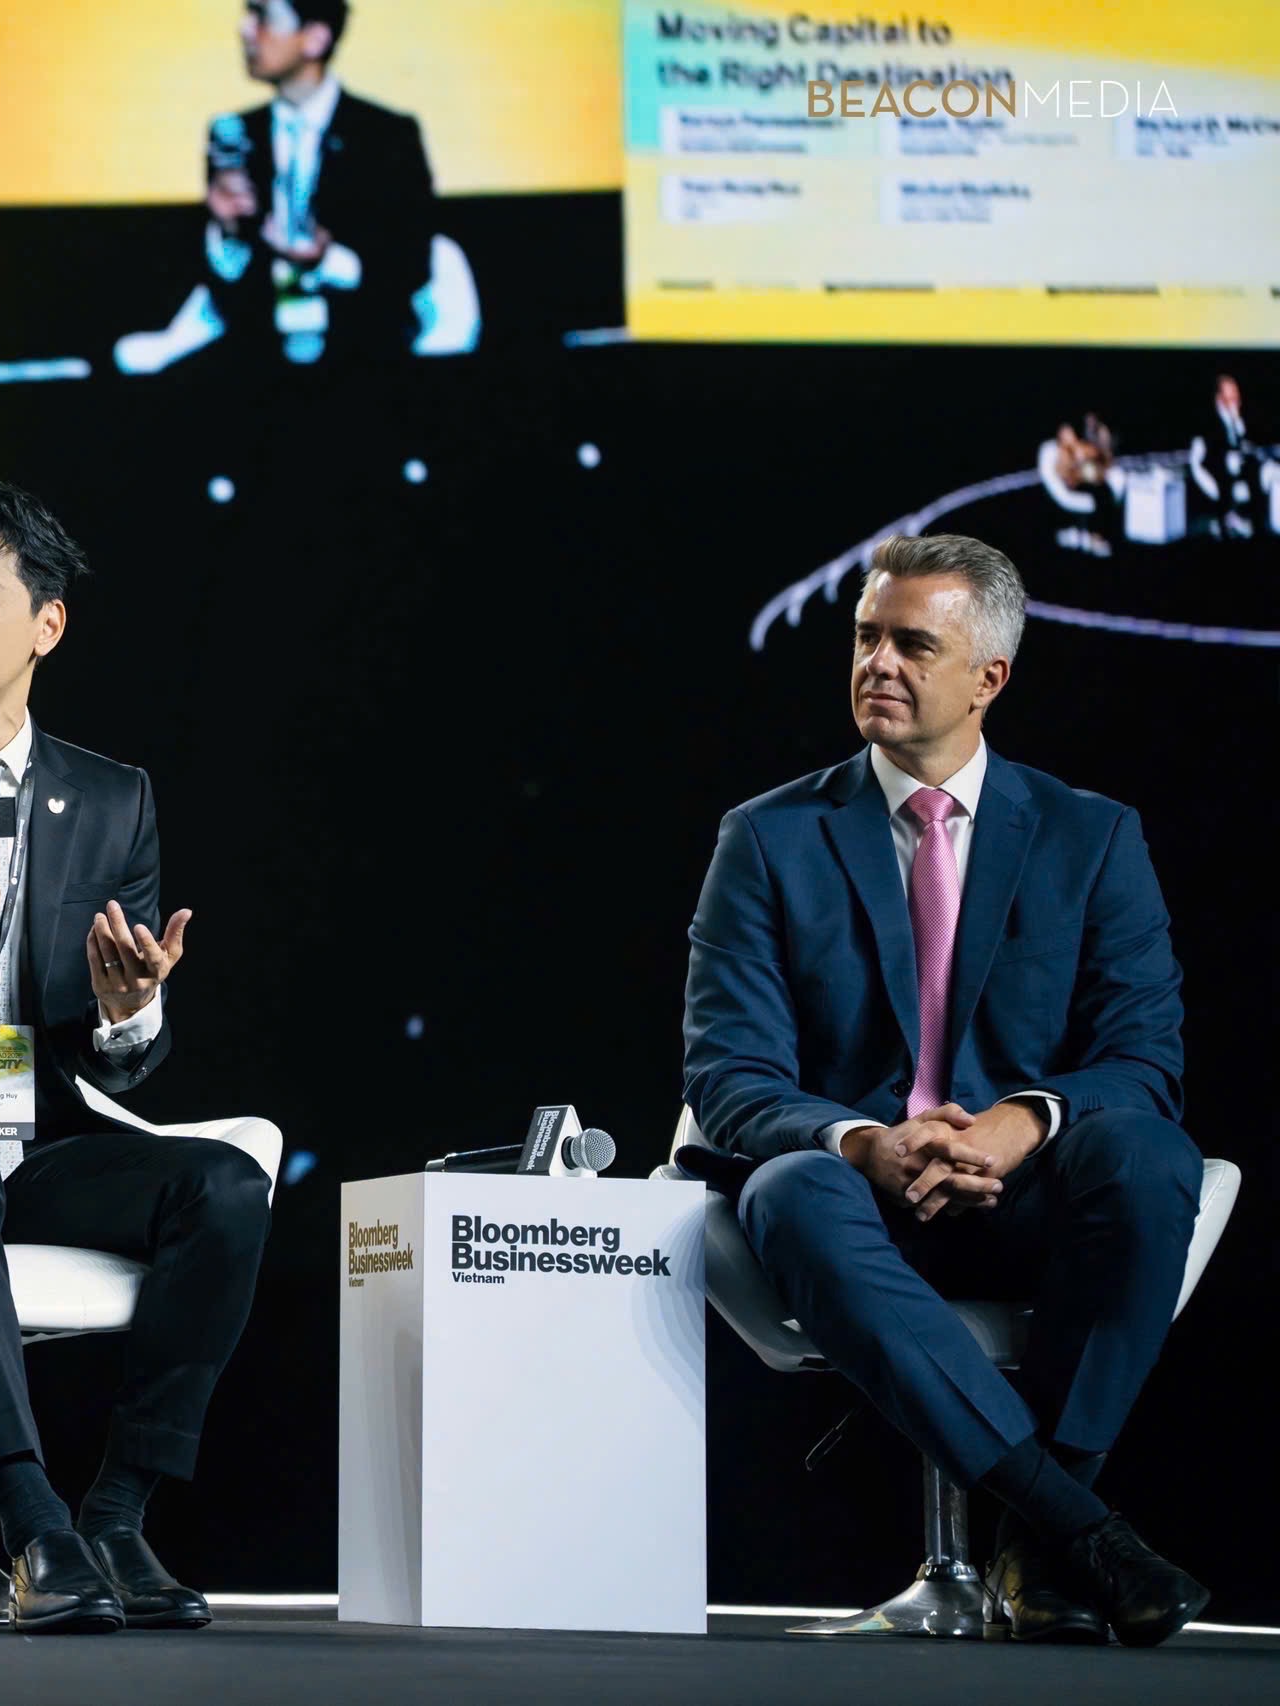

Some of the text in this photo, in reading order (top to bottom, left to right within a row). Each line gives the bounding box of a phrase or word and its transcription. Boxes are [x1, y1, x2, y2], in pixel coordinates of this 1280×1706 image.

[657, 10, 951, 50] Moving Capital to
[6, 1092, 18, 1100] Huy
[348, 1218, 399, 1250] Bloomberg
[451, 1214, 621, 1253] Bloomberg
[348, 1243, 414, 1275] Businessweek
[451, 1243, 671, 1277] Businessweek
[452, 1272, 505, 1284] Vietnam
